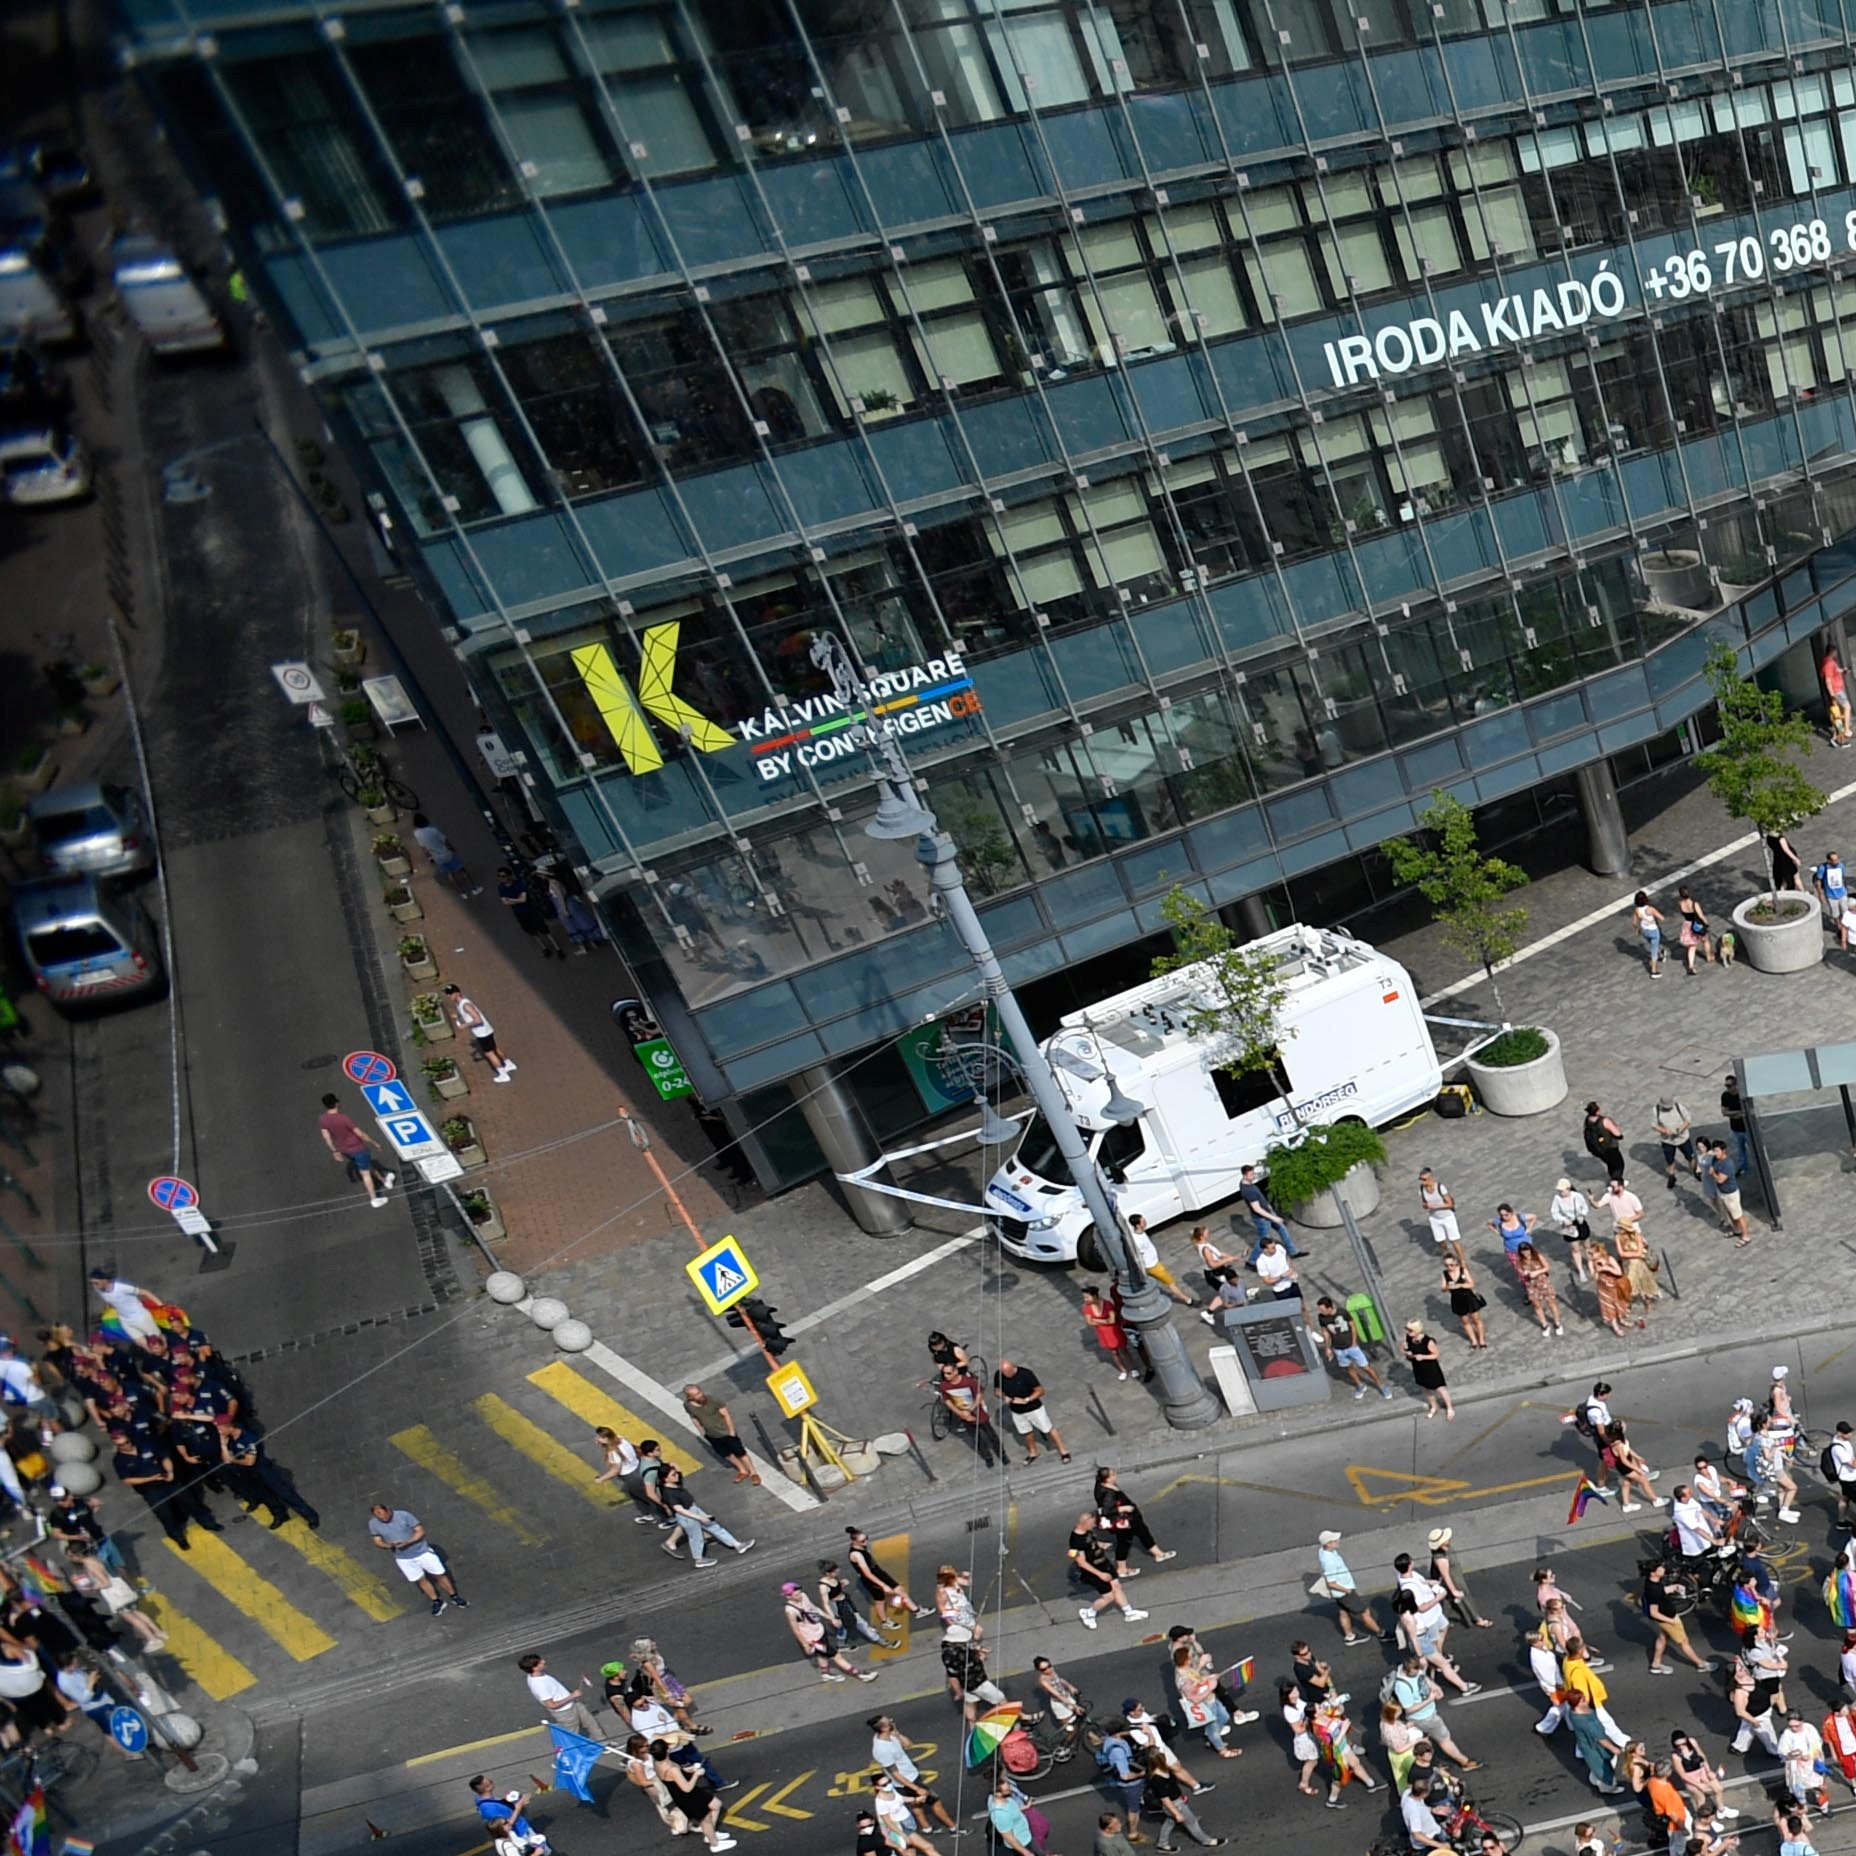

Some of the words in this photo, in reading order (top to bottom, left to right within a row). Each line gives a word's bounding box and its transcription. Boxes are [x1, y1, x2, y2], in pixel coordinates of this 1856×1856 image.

[1323, 308, 1481, 388] IRODA
[1481, 258, 1625, 345] KIADÓ
[1645, 249, 1713, 301] +36
[1716, 236, 1765, 285] 70
[1769, 218, 1831, 271] 368
[738, 694, 846, 741] KÁLVIN
[858, 650, 967, 701] SQUARE
[755, 752, 791, 781] BY
[1378, 977, 1393, 989] T3
[393, 1121, 418, 1143] P
